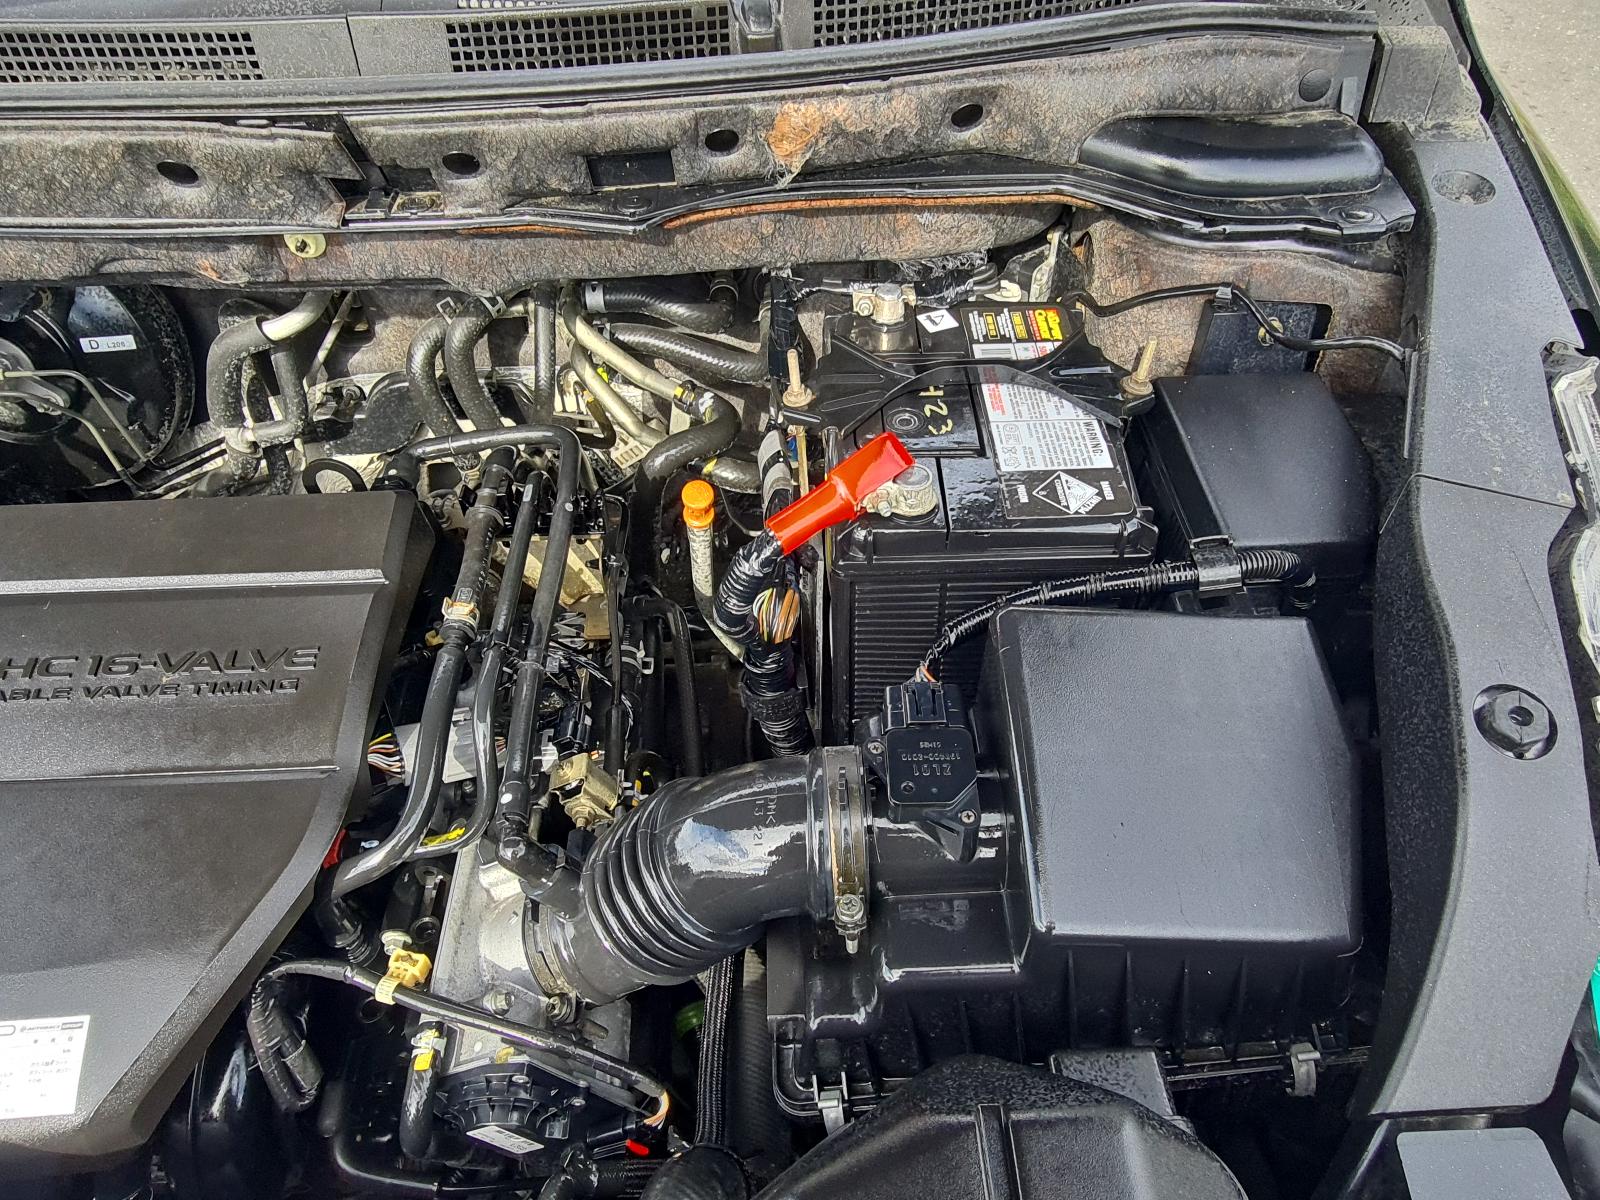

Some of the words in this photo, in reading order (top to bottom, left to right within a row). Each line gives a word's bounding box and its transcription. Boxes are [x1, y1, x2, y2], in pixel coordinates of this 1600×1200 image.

[88, 340, 99, 349] D
[1083, 421, 1104, 457] WARNING:
[87, 646, 320, 678] 16-VALVE
[83, 683, 181, 699] VALVE
[189, 678, 299, 697] TIMING
